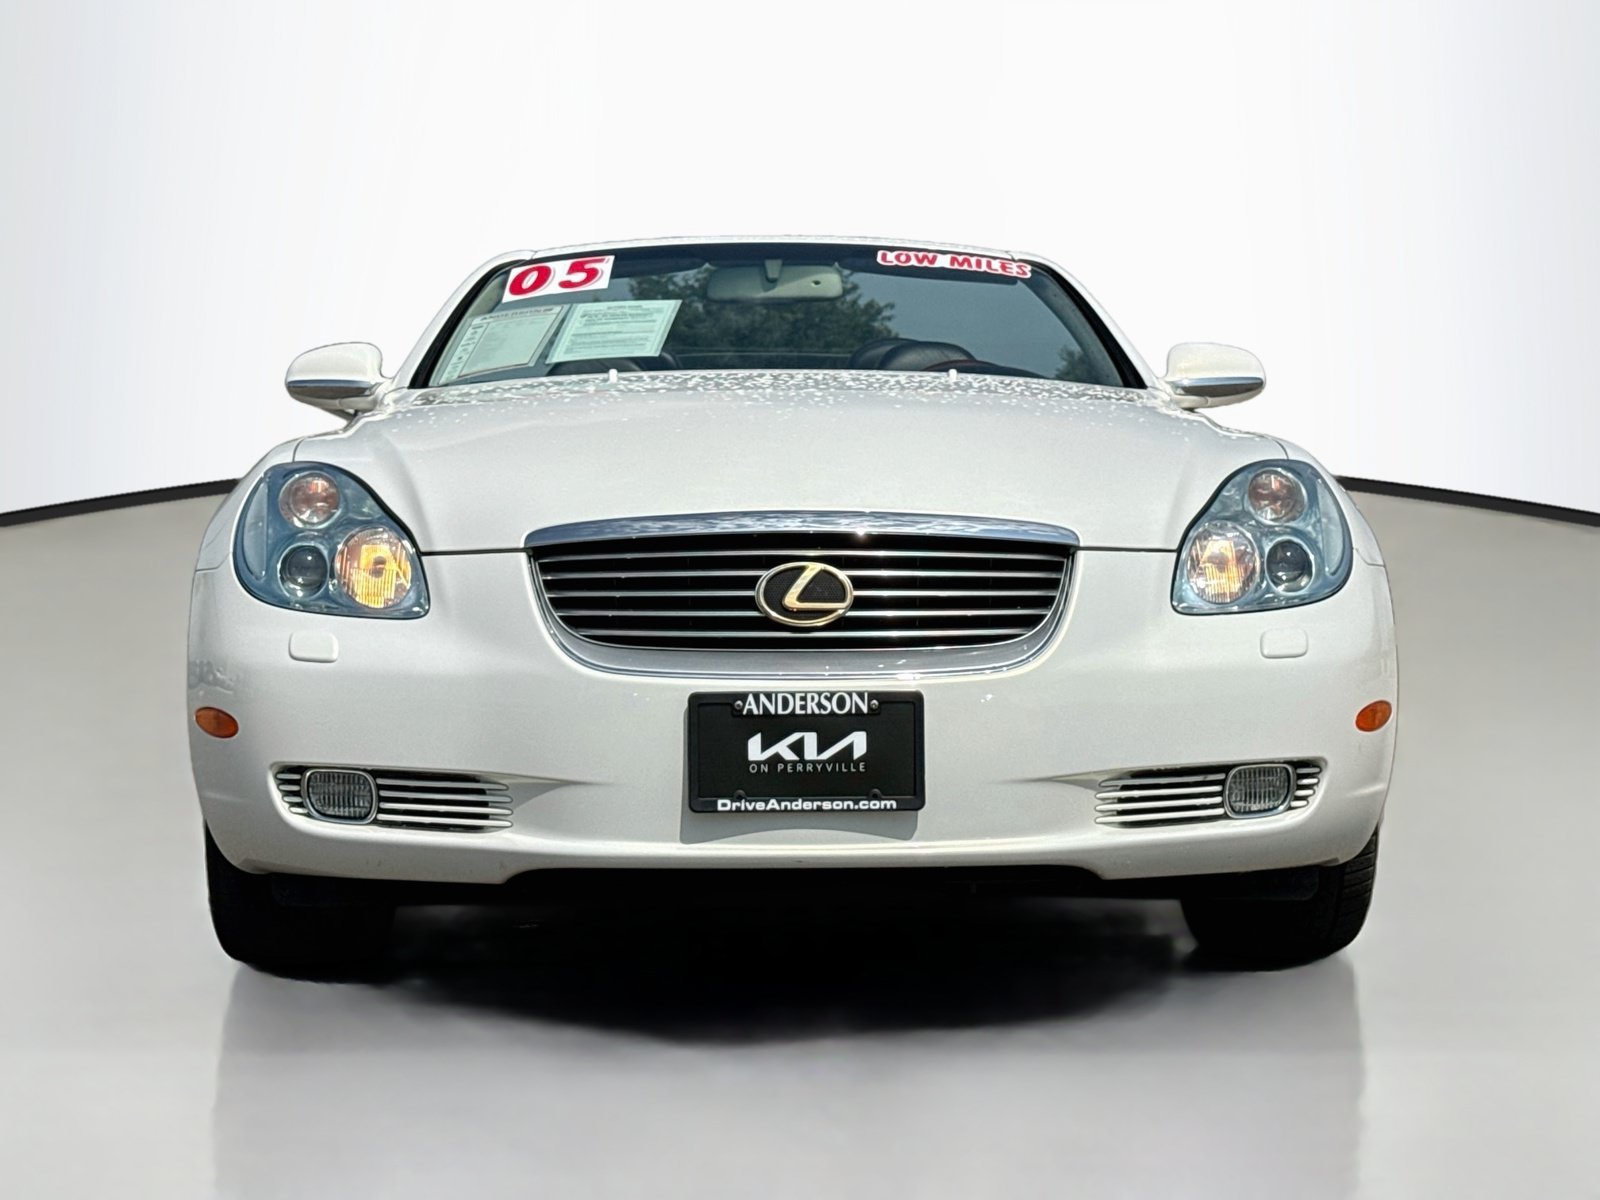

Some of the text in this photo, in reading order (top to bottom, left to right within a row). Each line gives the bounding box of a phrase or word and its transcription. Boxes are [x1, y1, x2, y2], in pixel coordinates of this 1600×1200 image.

[508, 256, 609, 297] 05
[880, 251, 1031, 277] LOW MILES
[742, 691, 868, 715] ANDERSON
[747, 730, 867, 761] KIA
[749, 761, 867, 774] ON PERRYVILLE
[716, 798, 898, 811] DriveAnderson.com
